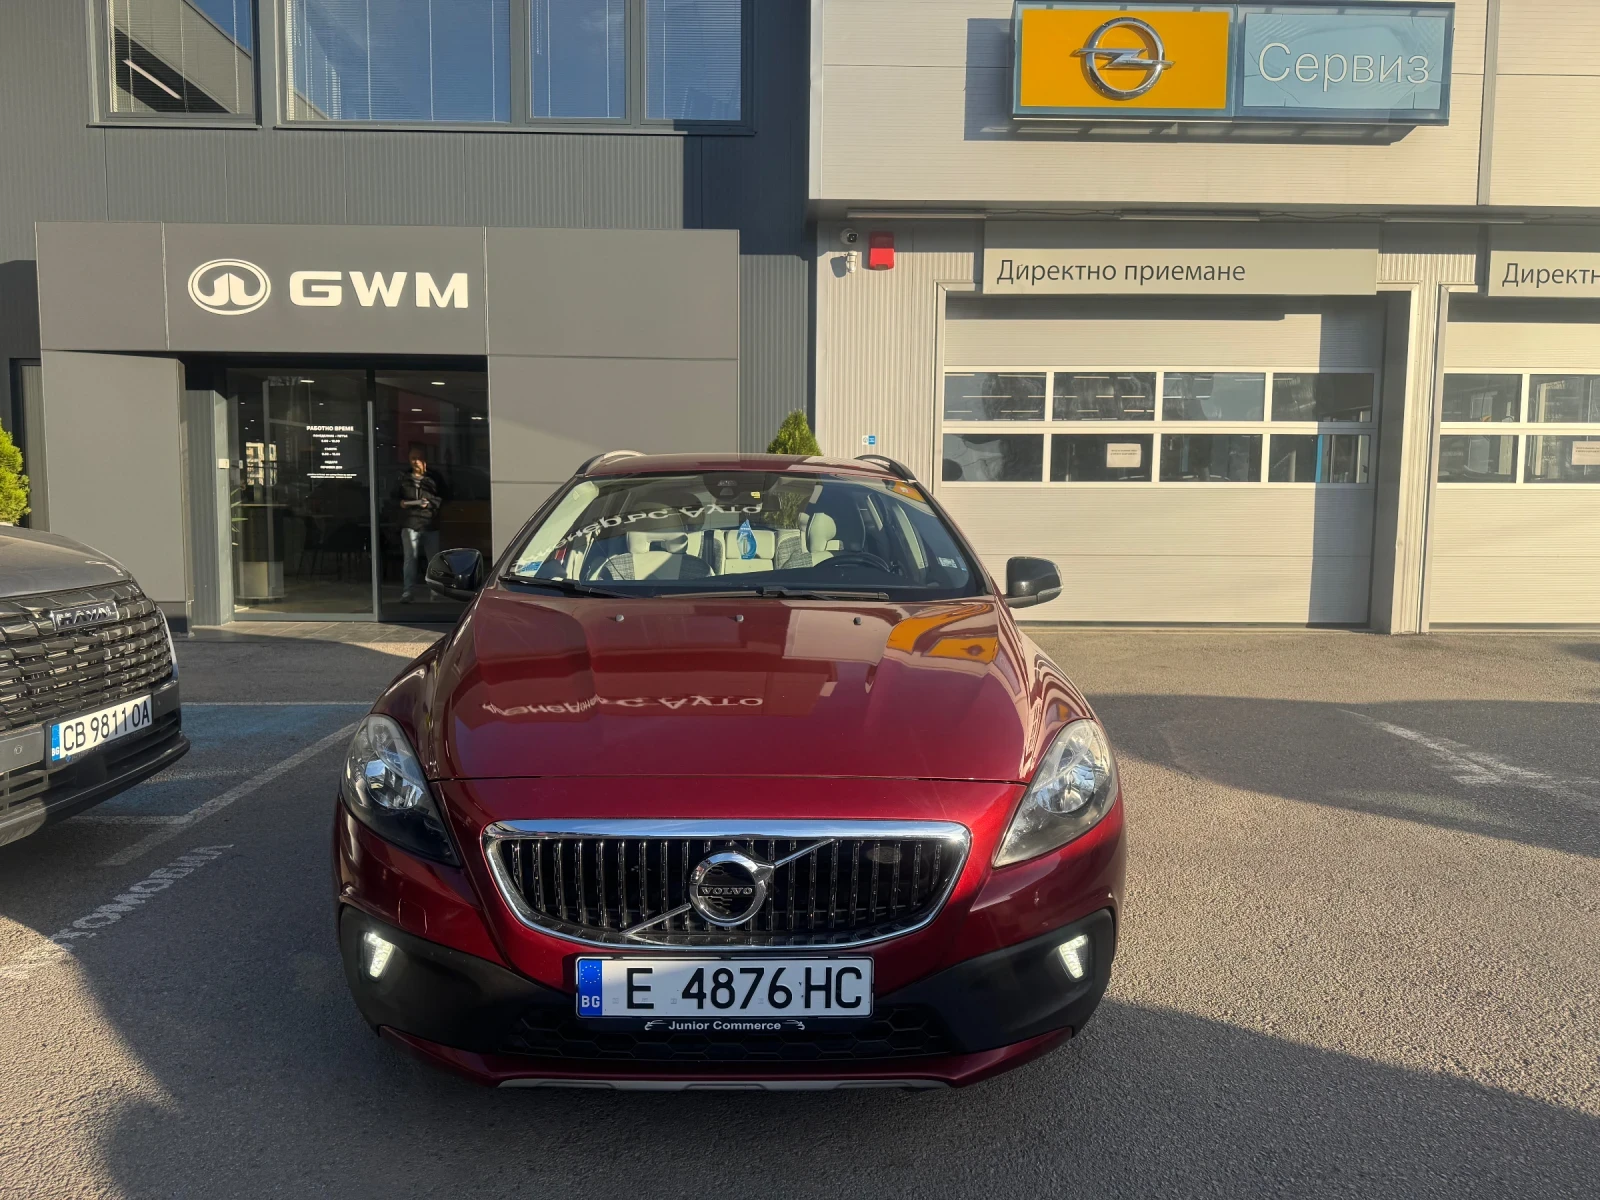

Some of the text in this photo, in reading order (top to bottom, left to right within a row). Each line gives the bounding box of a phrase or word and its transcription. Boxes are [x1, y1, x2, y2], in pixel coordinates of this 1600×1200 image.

[1259, 42, 1429, 93] Сервиз
[997, 259, 1246, 286] Директно приемане
[289, 270, 469, 309] GWM
[63, 700, 151, 752] CB 9811 OA
[51, 746, 60, 757] BG
[700, 886, 753, 895] VOLVO
[581, 995, 601, 1008] BG
[626, 966, 862, 1010] E 4876 HC
[668, 1020, 782, 1031] Junior Commerce
